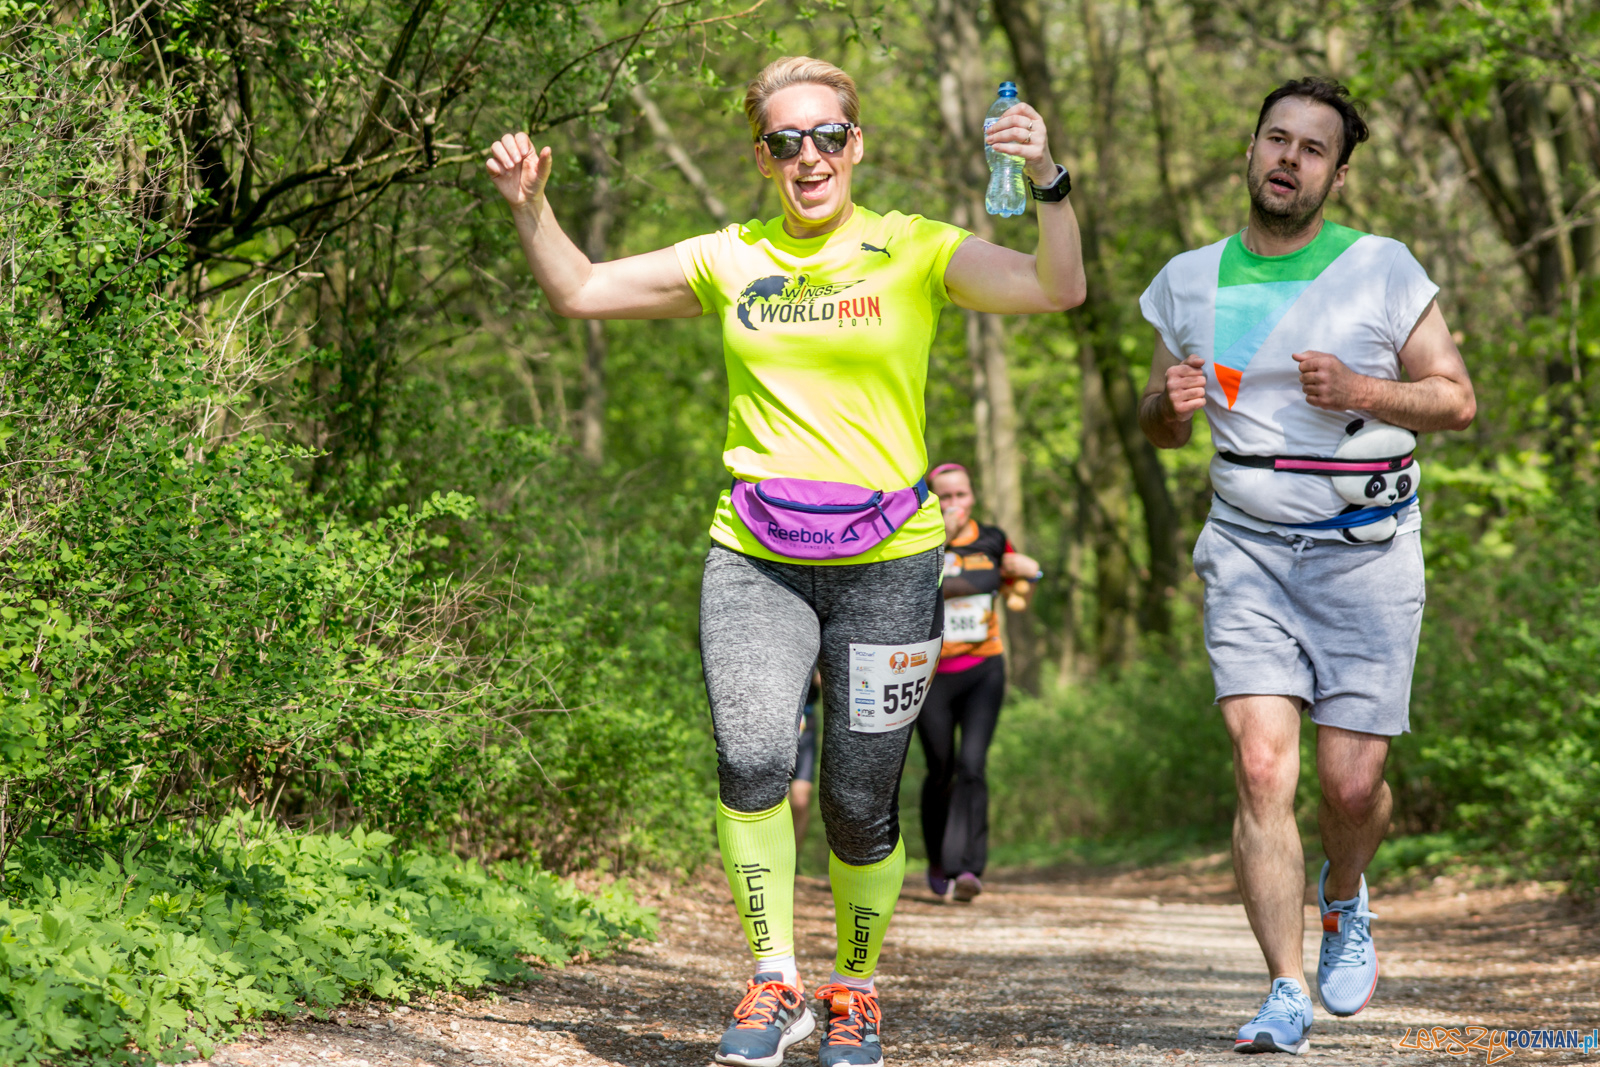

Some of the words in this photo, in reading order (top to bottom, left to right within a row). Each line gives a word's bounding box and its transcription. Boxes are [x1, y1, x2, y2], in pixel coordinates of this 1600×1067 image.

[785, 285, 833, 298] WINGS
[760, 302, 835, 323] WORLD
[838, 296, 881, 319] RUN
[838, 318, 882, 328] 2017
[768, 521, 835, 545] Reebok
[883, 676, 926, 715] 555
